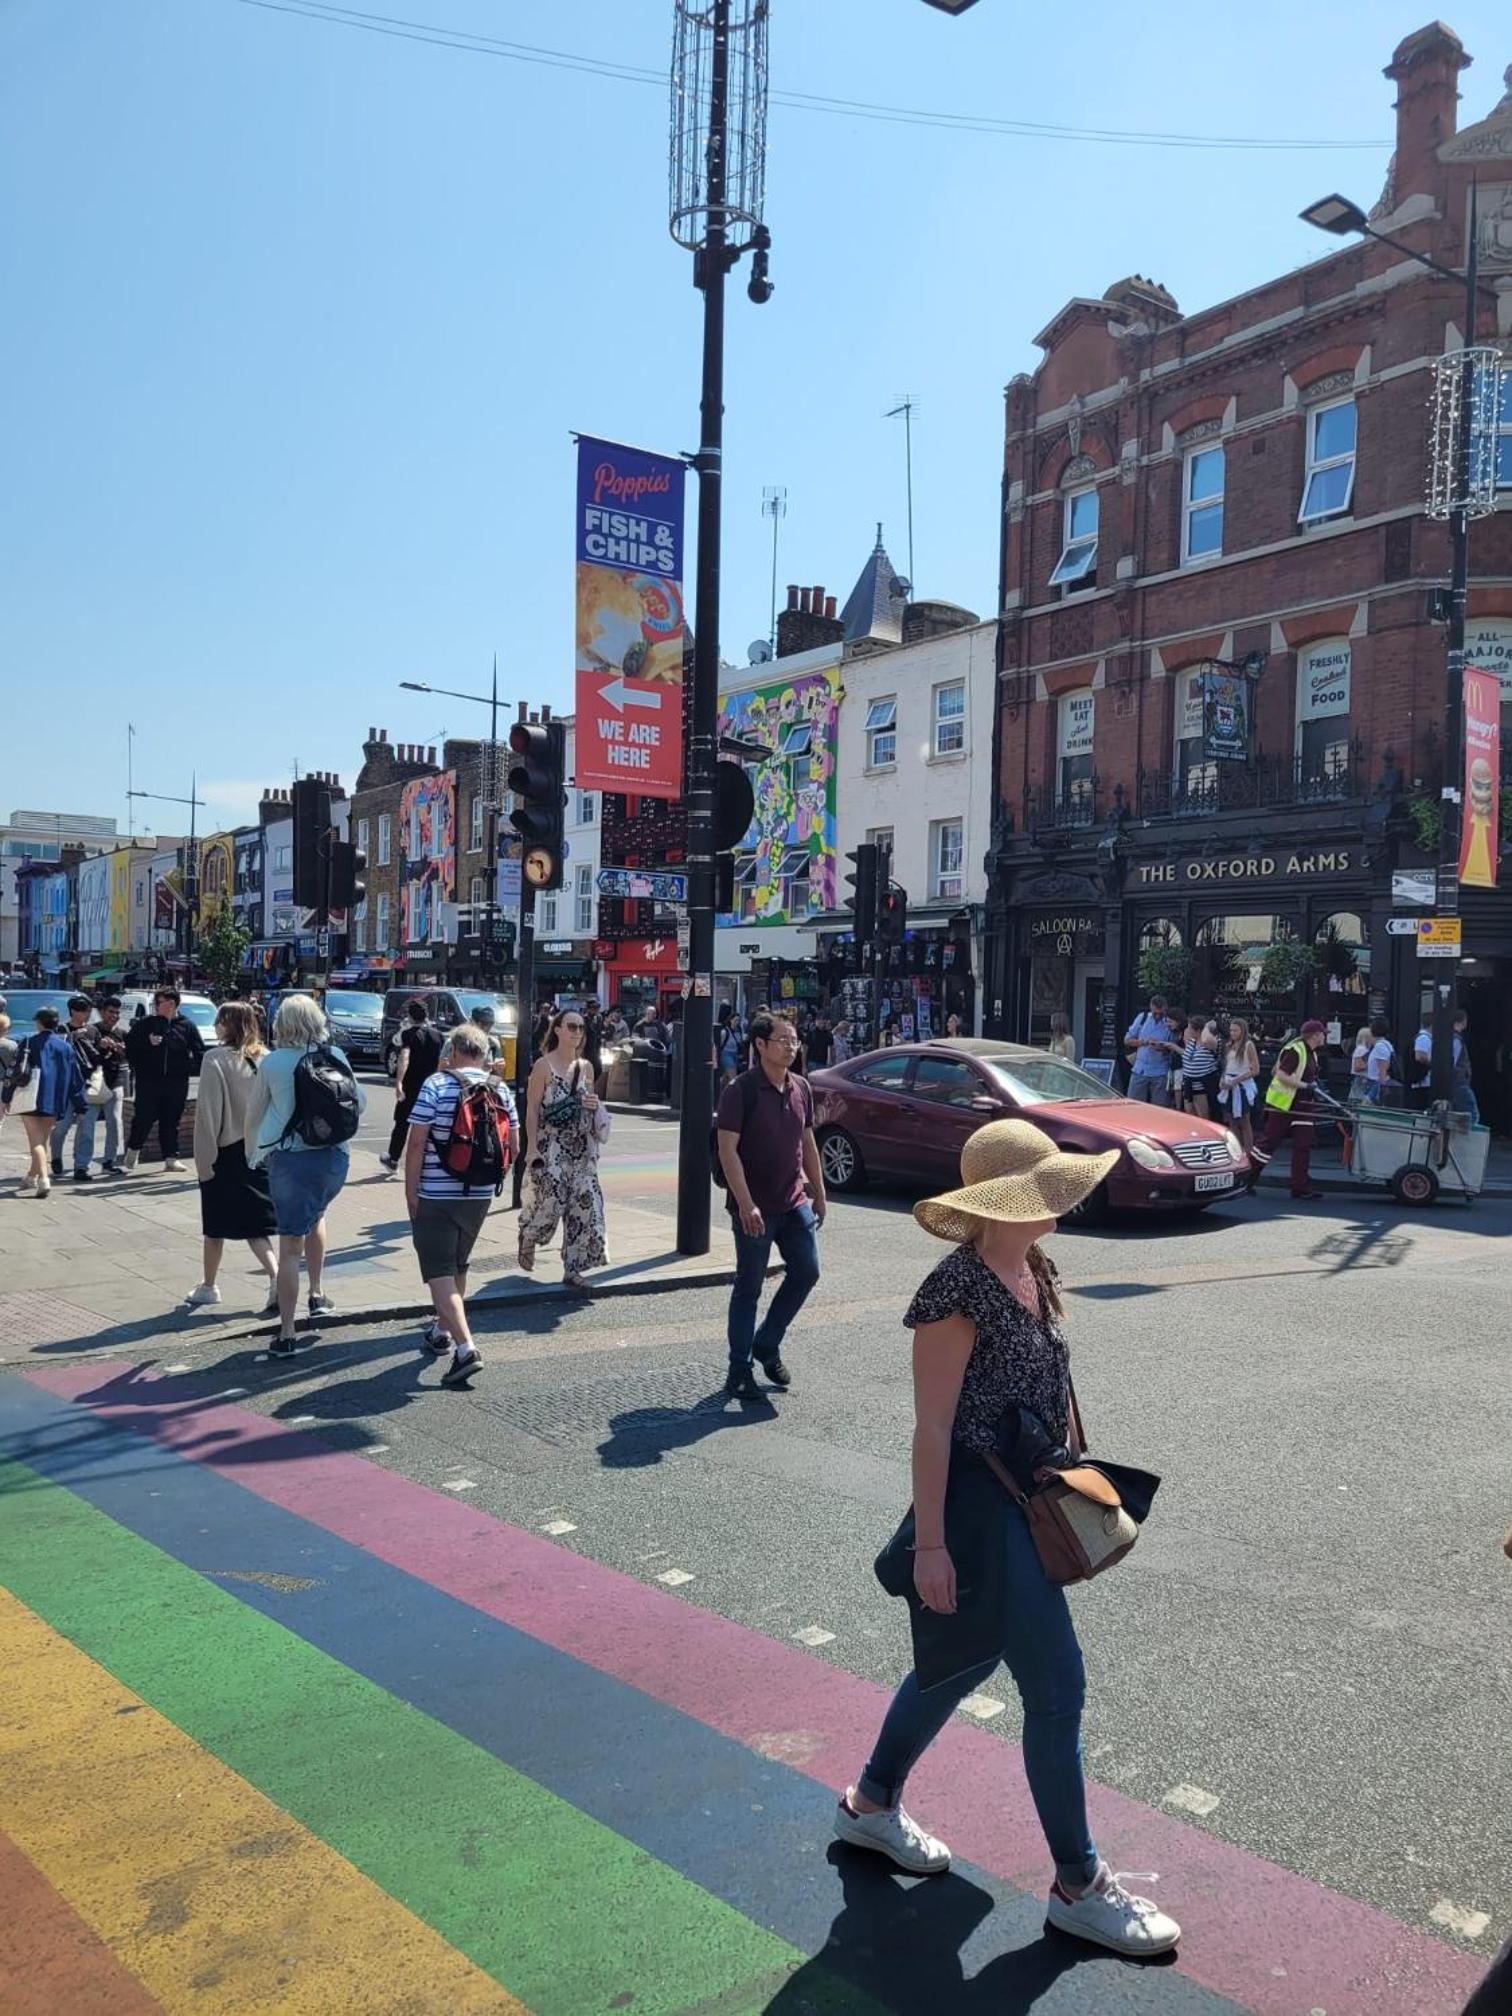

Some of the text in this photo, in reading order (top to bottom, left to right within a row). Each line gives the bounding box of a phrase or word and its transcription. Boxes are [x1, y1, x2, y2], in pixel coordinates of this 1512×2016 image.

[593, 463, 671, 503] Poppies
[585, 508, 675, 549] FISH &
[585, 534, 675, 571] CHIPS
[1478, 632, 1499, 641] ALL
[1310, 652, 1350, 670] FRESHLY
[1070, 699, 1093, 711] MEET
[1312, 690, 1346, 706] FOOD
[1075, 710, 1089, 721] EAT
[598, 718, 660, 746] WE ARE
[607, 744, 651, 769] HERE
[1140, 852, 1349, 882] THE OXFORD ARMS
[1031, 918, 1077, 937] SALOON
